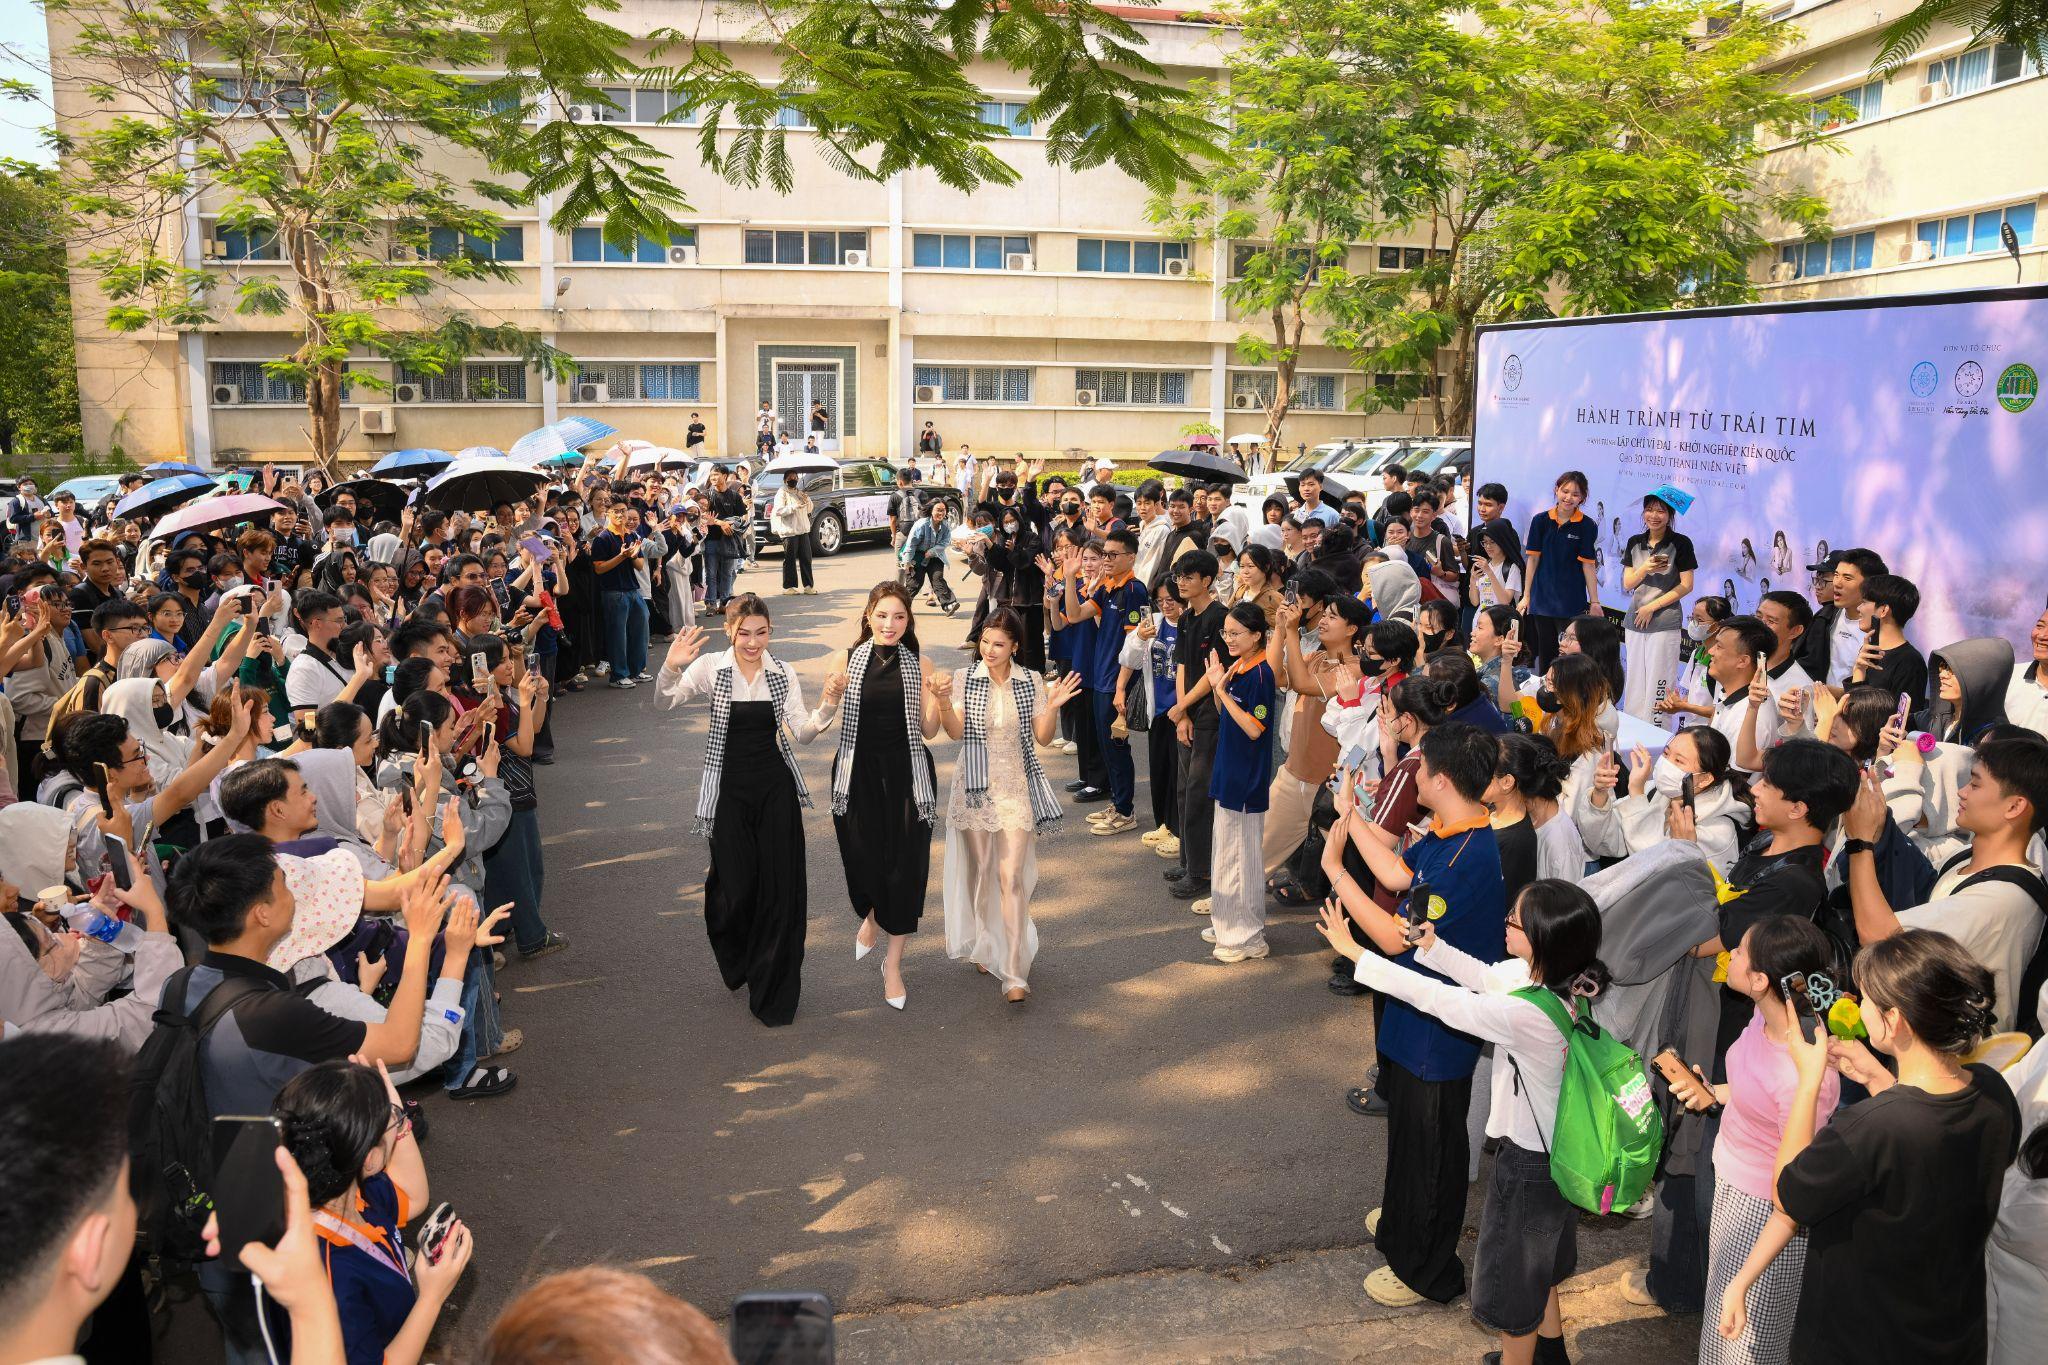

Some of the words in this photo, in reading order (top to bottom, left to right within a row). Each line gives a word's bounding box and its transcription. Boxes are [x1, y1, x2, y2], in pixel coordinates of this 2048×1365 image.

[1577, 405, 1619, 425] HÀNH
[1627, 407, 1680, 428] TRÌNH
[1689, 409, 1713, 430] TỪ
[1721, 411, 1765, 434] TRÁI
[1776, 416, 1817, 437] TIM
[1765, 446, 1797, 463] QUỐC
[1668, 457, 1699, 470] THANH
